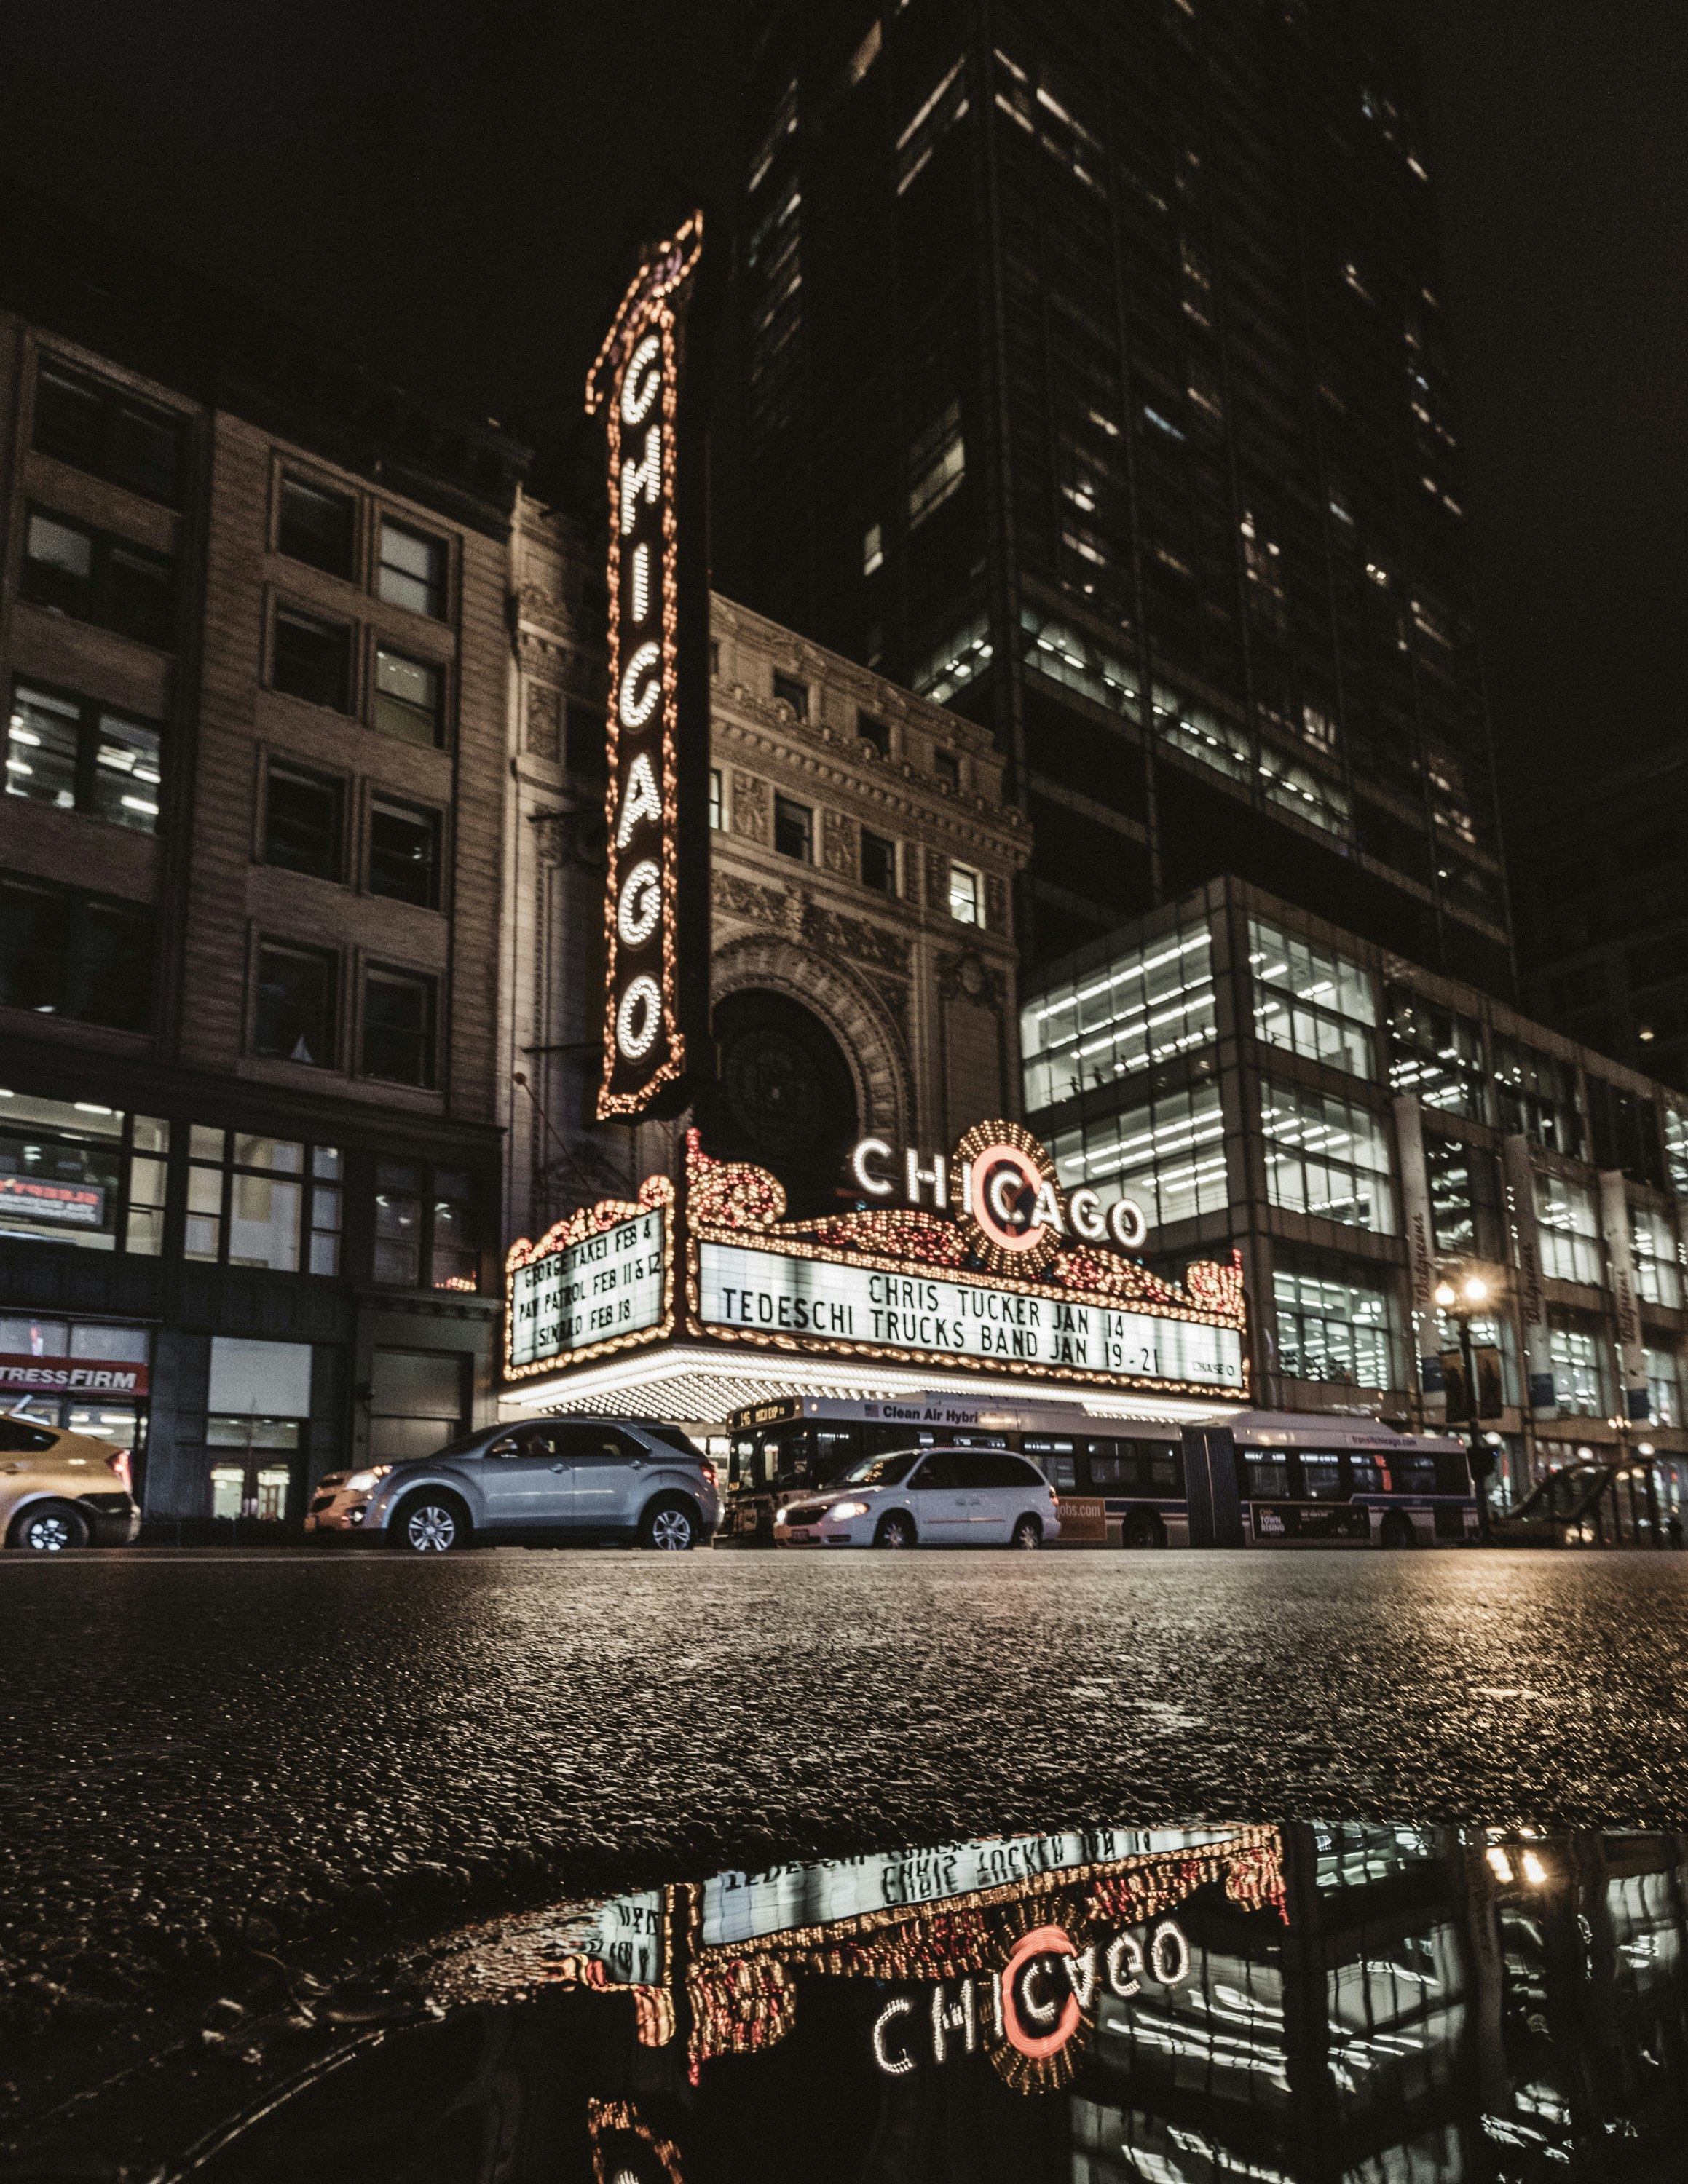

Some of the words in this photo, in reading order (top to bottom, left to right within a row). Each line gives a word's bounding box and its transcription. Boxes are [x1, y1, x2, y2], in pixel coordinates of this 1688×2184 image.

[617, 334, 663, 1060] CHICAGO
[853, 1138, 1148, 1248] CHICAGO
[572, 1237, 607, 1267] TAKEI
[616, 1224, 637, 1252] FEB
[545, 1281, 585, 1313] PATROL
[594, 1269, 616, 1295] FEB
[624, 1262, 631, 1284] 11
[649, 1252, 660, 1275] 12
[869, 1275, 938, 1311] CHRIS
[958, 1289, 1040, 1327] TUCKER
[1052, 1304, 1089, 1334] JAN
[1107, 1314, 1124, 1340] 14
[591, 1305, 612, 1330] FEB
[619, 1299, 630, 1322] 18
[722, 1287, 853, 1334] TEDESCHI
[869, 1309, 965, 1348] TRUCKS
[982, 1325, 1038, 1358] BAND
[1049, 1335, 1087, 1364] JAN
[883, 1406, 920, 1420] Clean
[924, 1409, 943, 1421] Air
